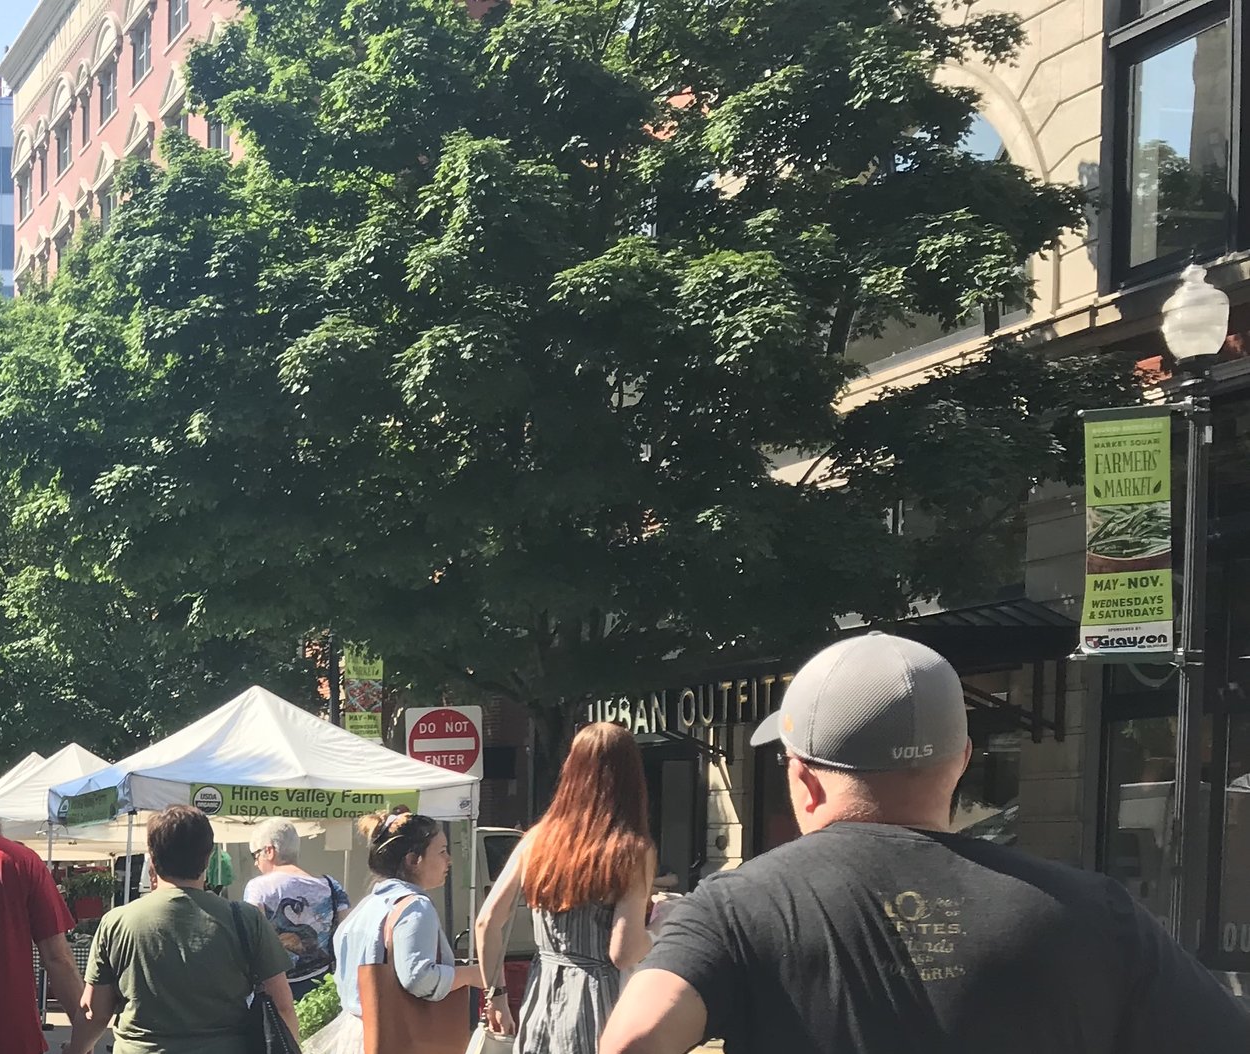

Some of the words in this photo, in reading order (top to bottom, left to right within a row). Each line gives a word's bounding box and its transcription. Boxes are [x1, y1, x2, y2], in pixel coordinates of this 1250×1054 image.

[1094, 440, 1127, 448] MARKET
[1103, 476, 1153, 499] MARKET
[1091, 595, 1164, 609] WEDNESDAYS
[1097, 606, 1164, 619] SATURDAYS
[680, 673, 795, 728] OUTFITT
[419, 723, 436, 734] DO
[445, 721, 469, 733] NOT
[893, 744, 933, 759] VOLS
[425, 754, 465, 766] ENTER
[231, 786, 279, 802] Hines
[286, 788, 336, 806] Valley
[342, 790, 385, 804] Farm
[229, 804, 267, 816] USDA
[272, 806, 328, 818] Certified
